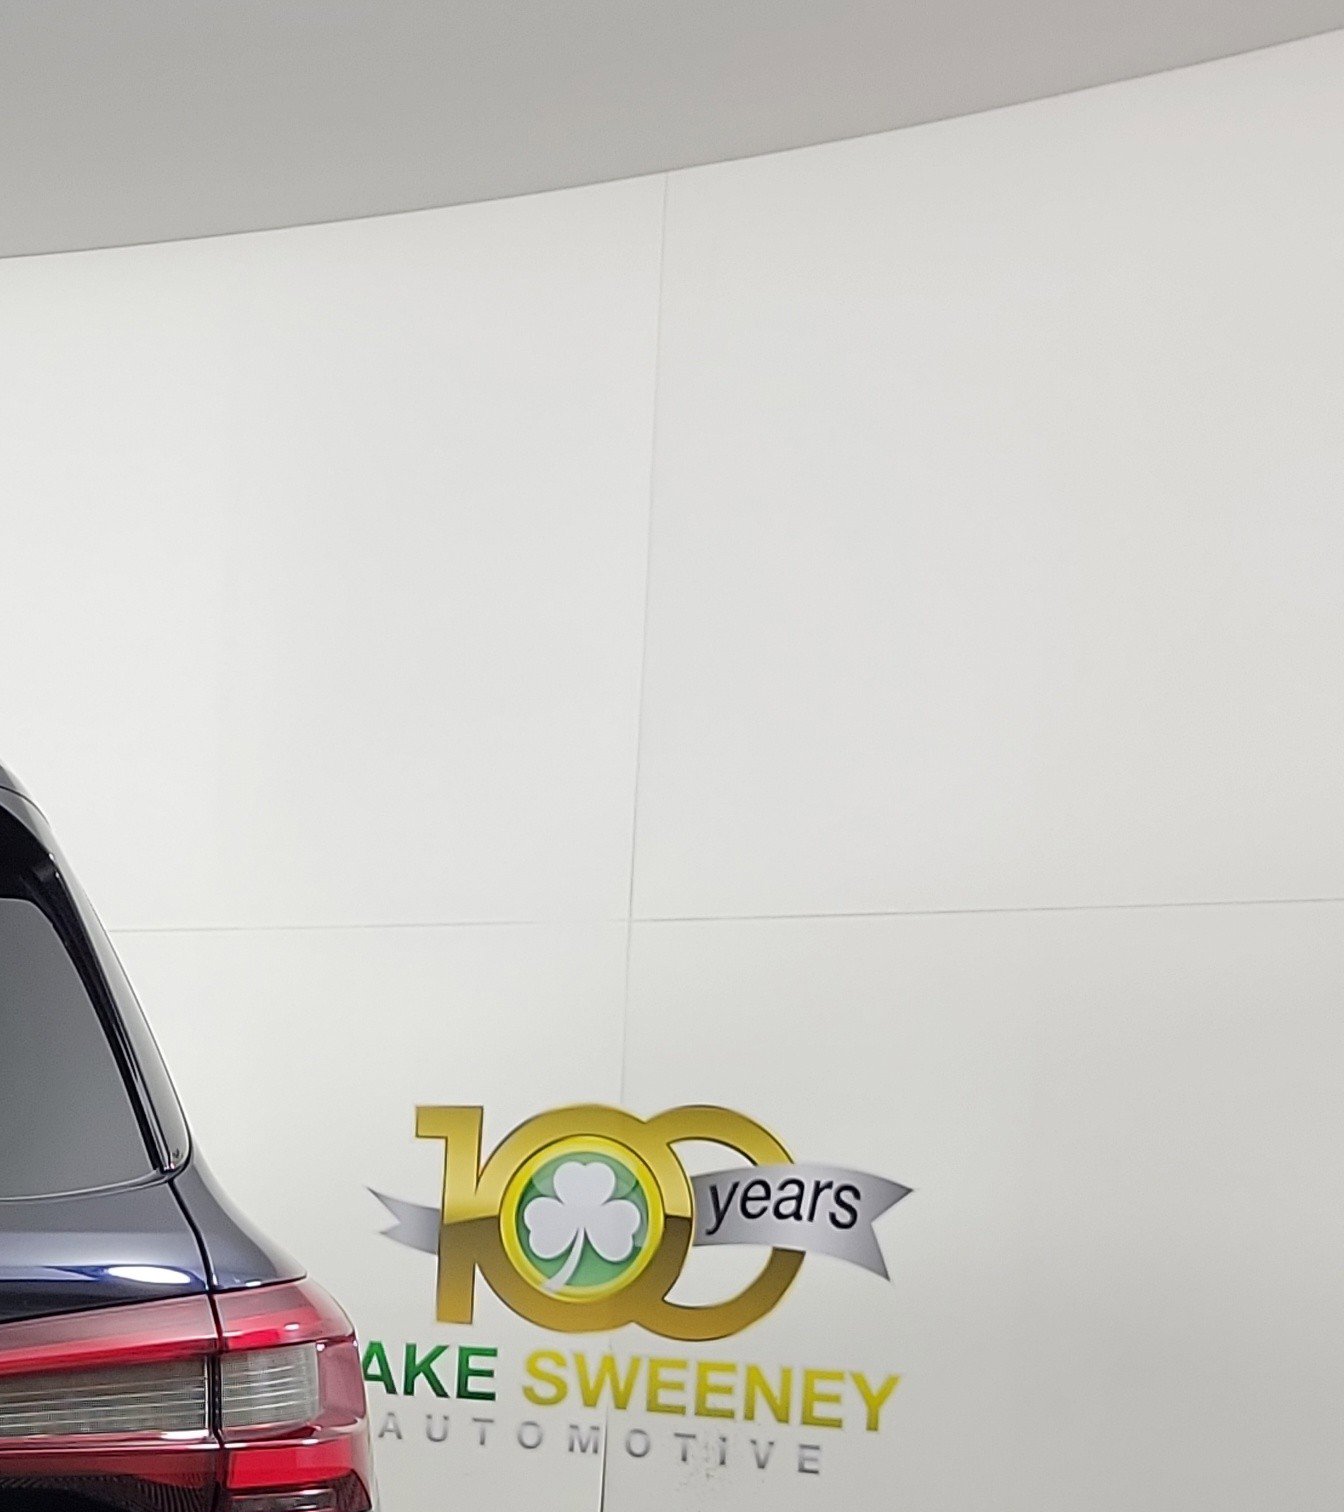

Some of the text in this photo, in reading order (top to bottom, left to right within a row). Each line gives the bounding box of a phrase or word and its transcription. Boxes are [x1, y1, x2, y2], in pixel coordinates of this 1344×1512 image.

[415, 1103, 863, 1342] 100 years
[362, 1340, 901, 1432] AKE SWEENEY
[377, 1411, 821, 1474] AUTOMOTIVE
